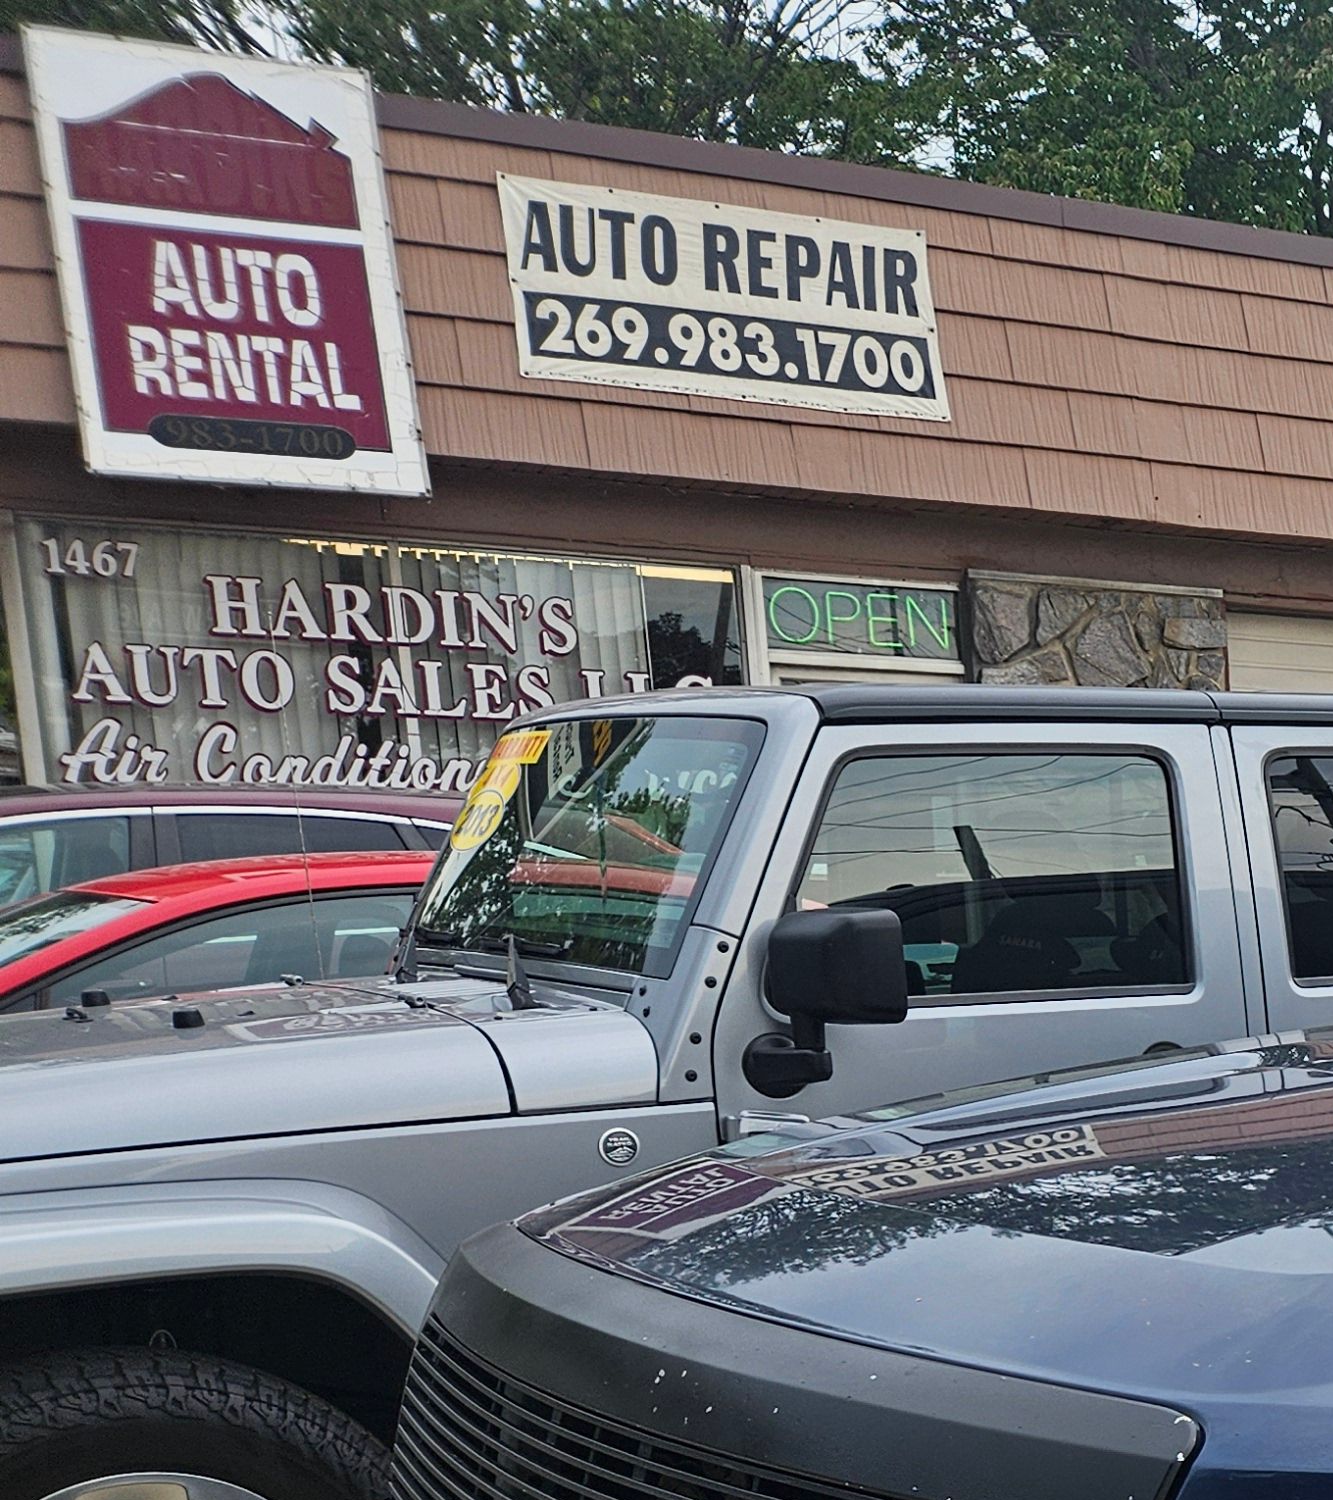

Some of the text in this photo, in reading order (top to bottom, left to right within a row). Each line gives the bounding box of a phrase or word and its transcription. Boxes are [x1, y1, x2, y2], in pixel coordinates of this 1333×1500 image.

[152, 240, 322, 327] AUTO
[521, 201, 920, 317] AUTO REPAIR
[127, 325, 362, 411] RENTAL
[536, 298, 926, 393] 269.983.1700
[164, 419, 344, 456] 983-1700
[41, 537, 139, 578] 1467
[204, 573, 578, 657] HARDIN'S
[768, 586, 951, 651] OPEN
[73, 642, 295, 711] AUTO
[327, 655, 554, 720] SALES
[61, 719, 169, 785] Air
[197, 722, 490, 790] Condition
